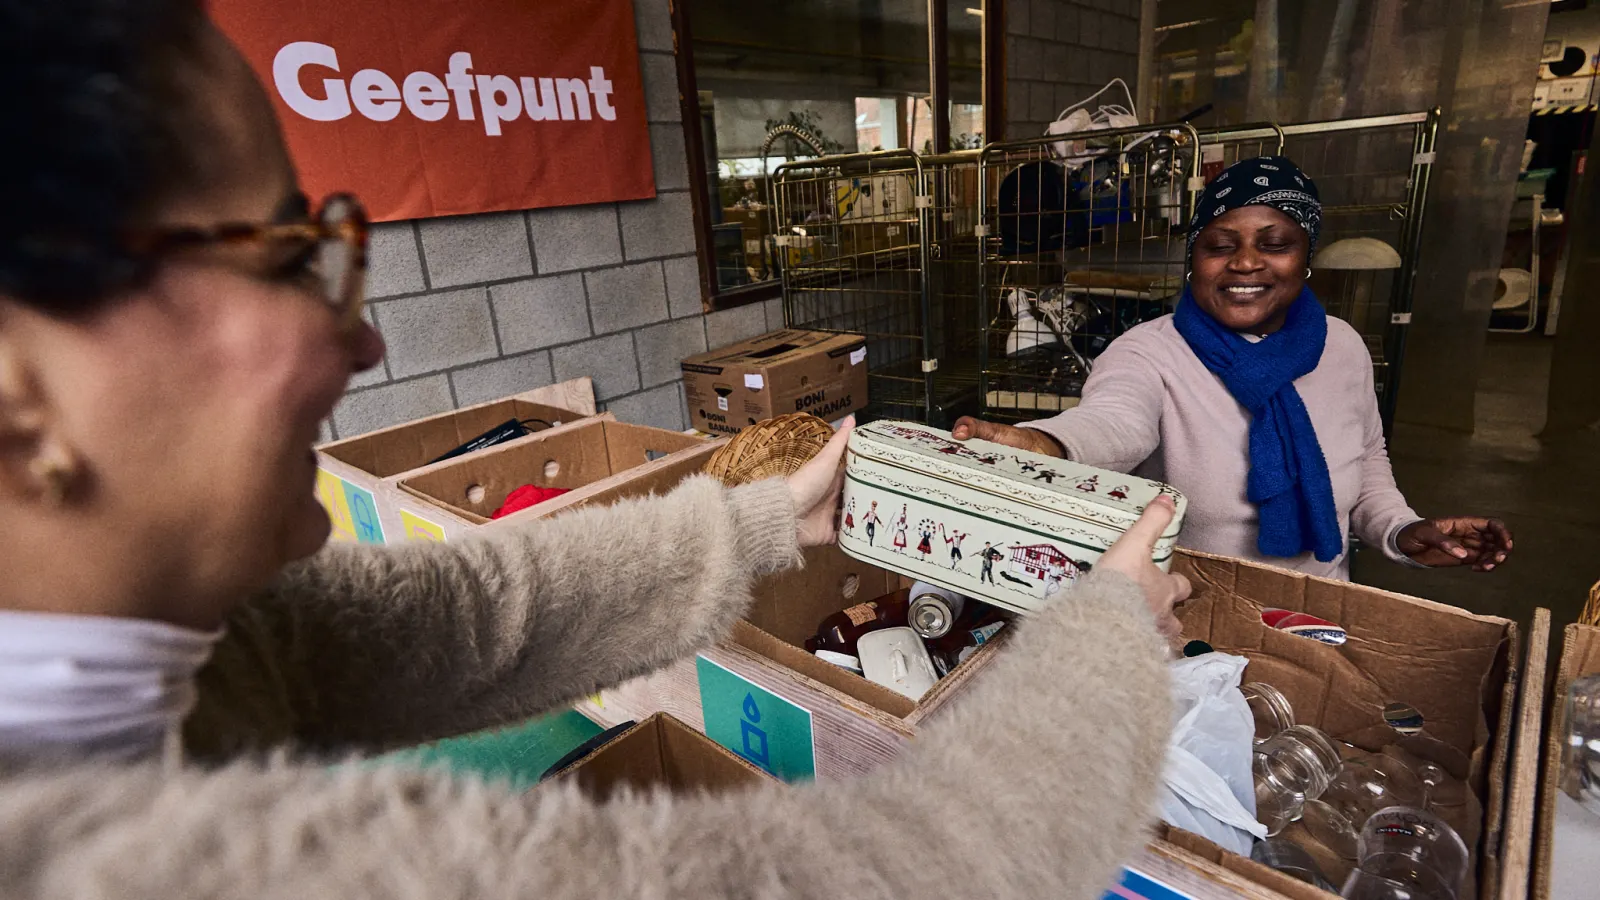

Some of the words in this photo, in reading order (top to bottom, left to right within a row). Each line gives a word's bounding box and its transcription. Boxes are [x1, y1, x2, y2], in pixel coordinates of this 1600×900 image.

[272, 41, 616, 136] Geefpunt
[796, 389, 825, 410] BONI
[806, 395, 852, 418] NANAS
[706, 413, 726, 423] BONI
[708, 422, 742, 433] BANANA
